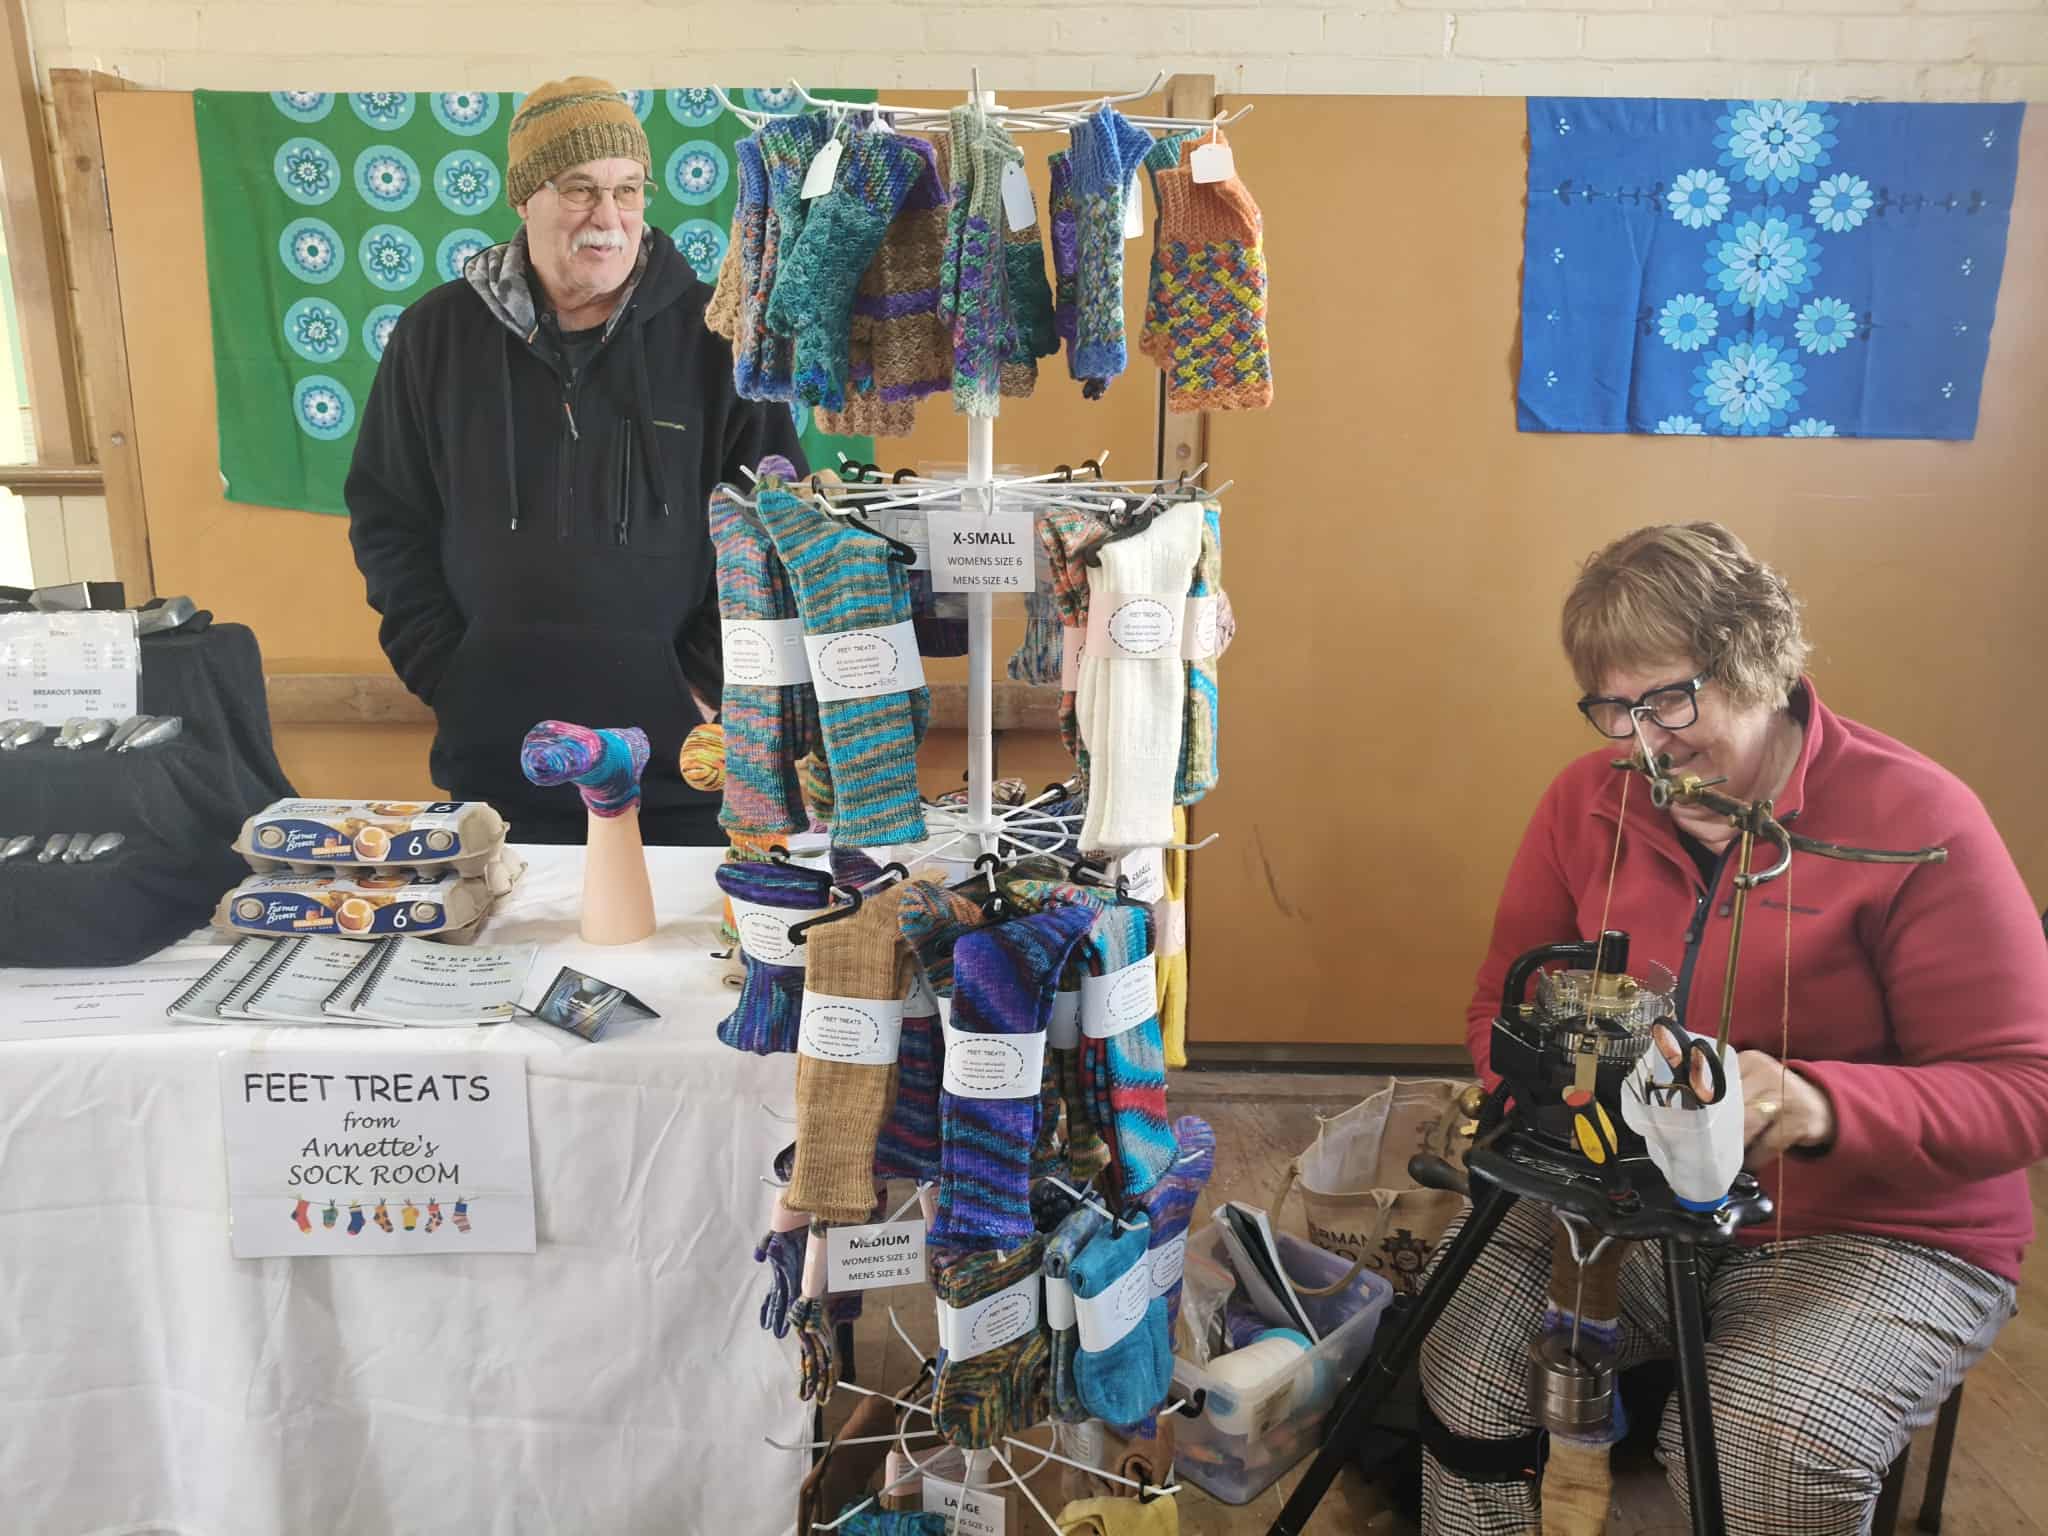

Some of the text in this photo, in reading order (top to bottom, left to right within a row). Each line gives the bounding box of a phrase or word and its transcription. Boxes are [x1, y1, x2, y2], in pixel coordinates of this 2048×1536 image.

[952, 532, 1016, 545] X-SMALL
[947, 556, 1023, 567] WOMENS SIZE 6
[952, 576, 1018, 585] MENS SIZE 4.5
[32, 688, 71, 697] BREAKOUT
[433, 803, 451, 812] 6
[408, 836, 423, 856] 6
[392, 908, 408, 928] 6
[244, 1073, 491, 1103] FEET TREATS
[343, 1111, 400, 1132] from
[301, 1135, 440, 1158] Annette's
[287, 1162, 460, 1186] SOCK ROOM
[841, 1251, 918, 1267] WOMENS SIZE 10
[848, 1271, 875, 1281] MENS
[876, 1269, 896, 1279] SIZE
